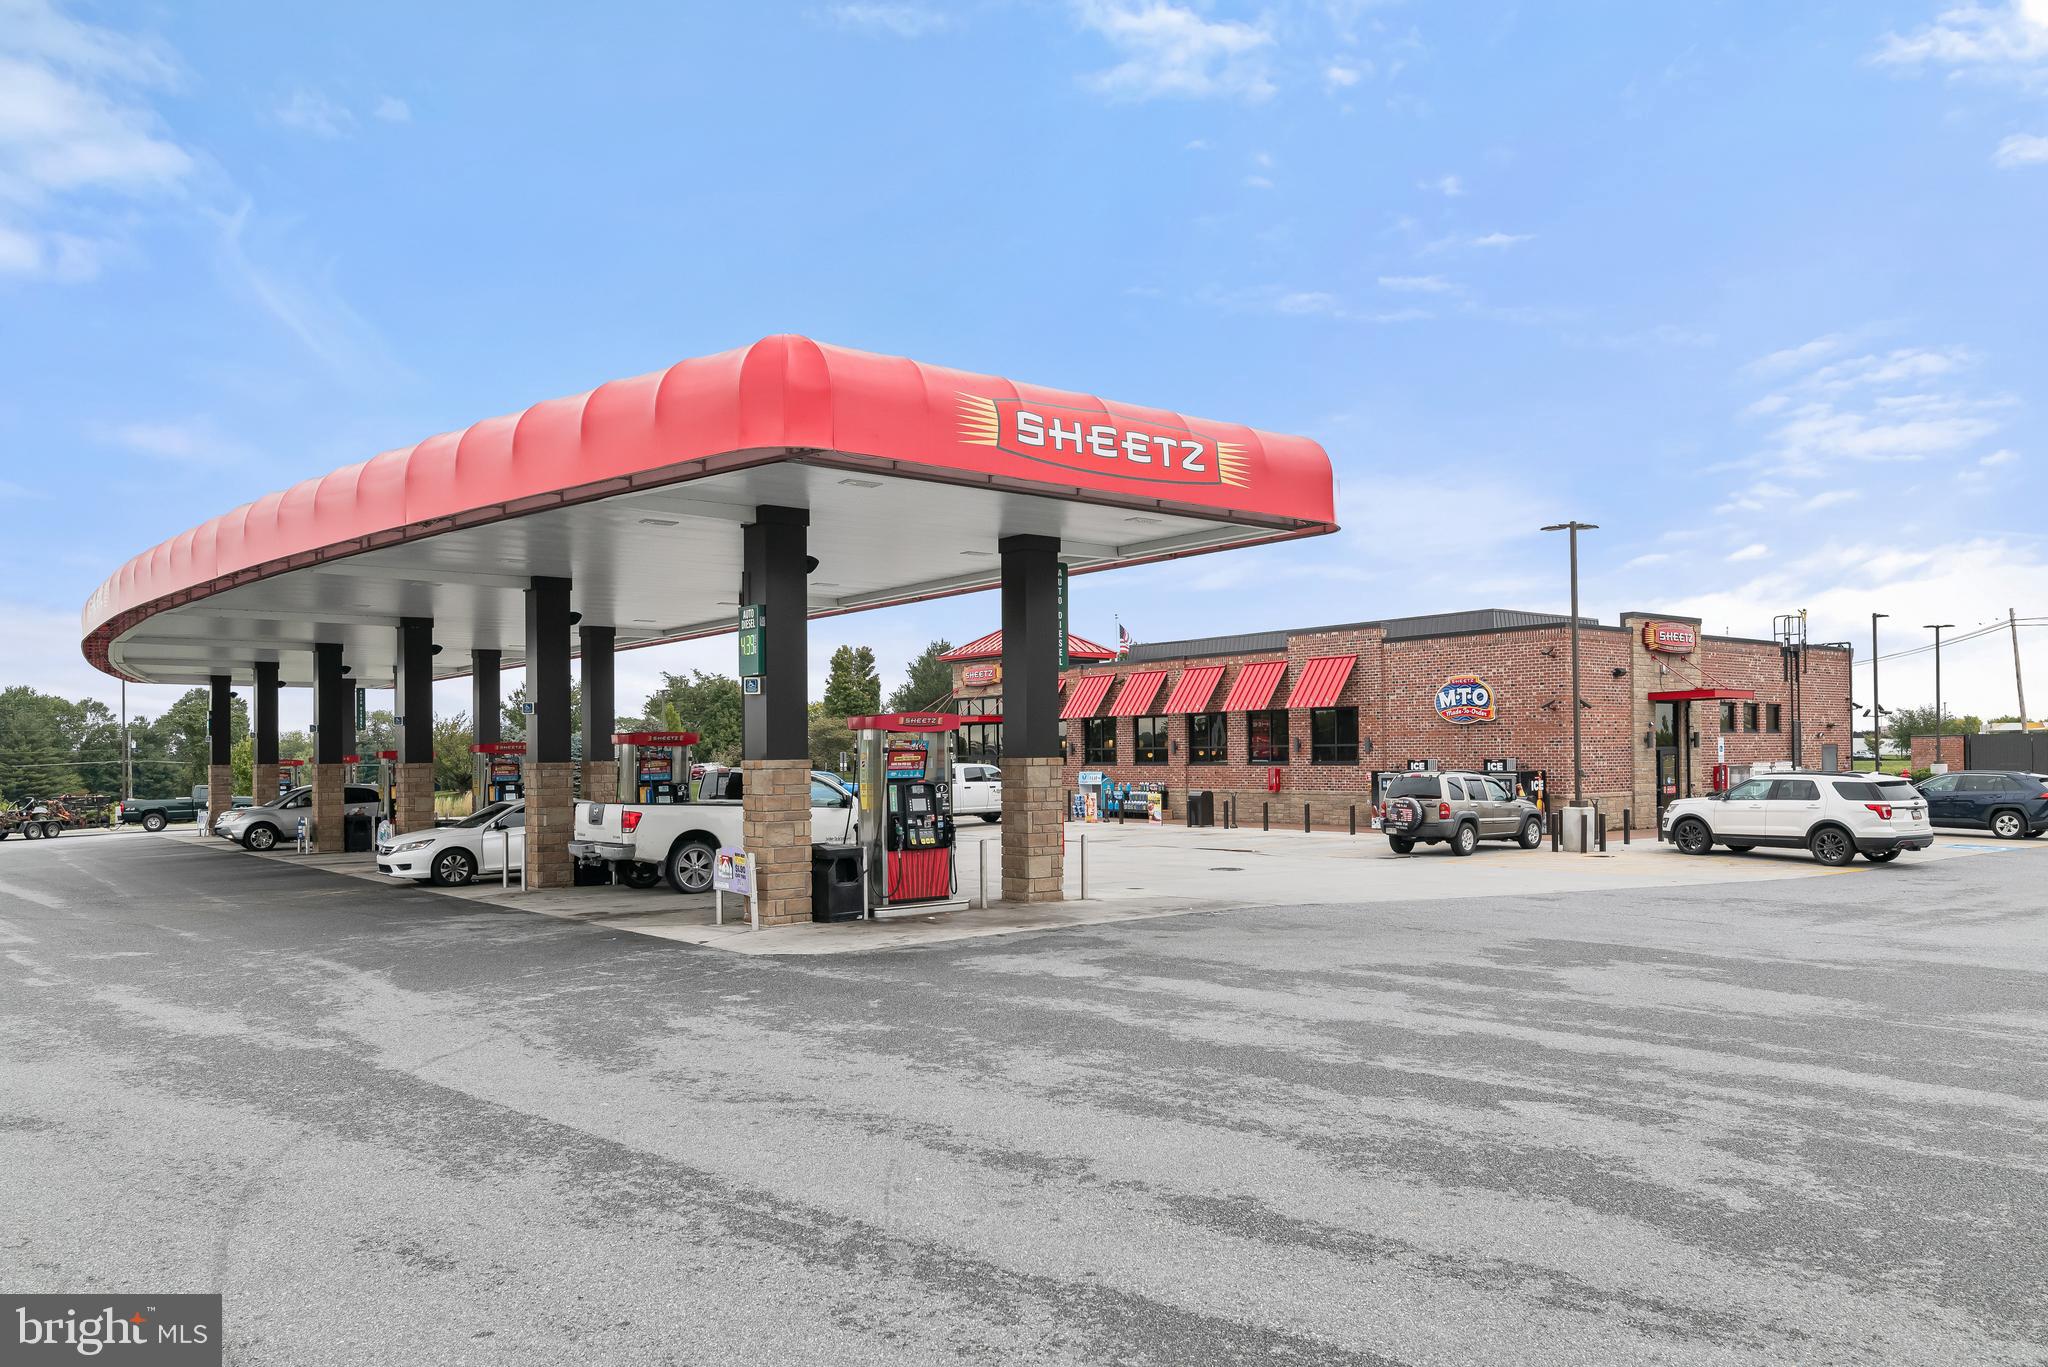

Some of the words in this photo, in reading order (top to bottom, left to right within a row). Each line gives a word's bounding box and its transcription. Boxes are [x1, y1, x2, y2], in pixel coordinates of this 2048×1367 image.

[1016, 410, 1206, 473] SHEETZ
[743, 608, 754, 619] AUTO
[742, 618, 755, 629] DIESEL
[1659, 631, 1693, 643] SHEETZ
[965, 670, 993, 678] SHEETZ
[1411, 762, 1425, 770] ICE
[1488, 762, 1504, 771] ICE
